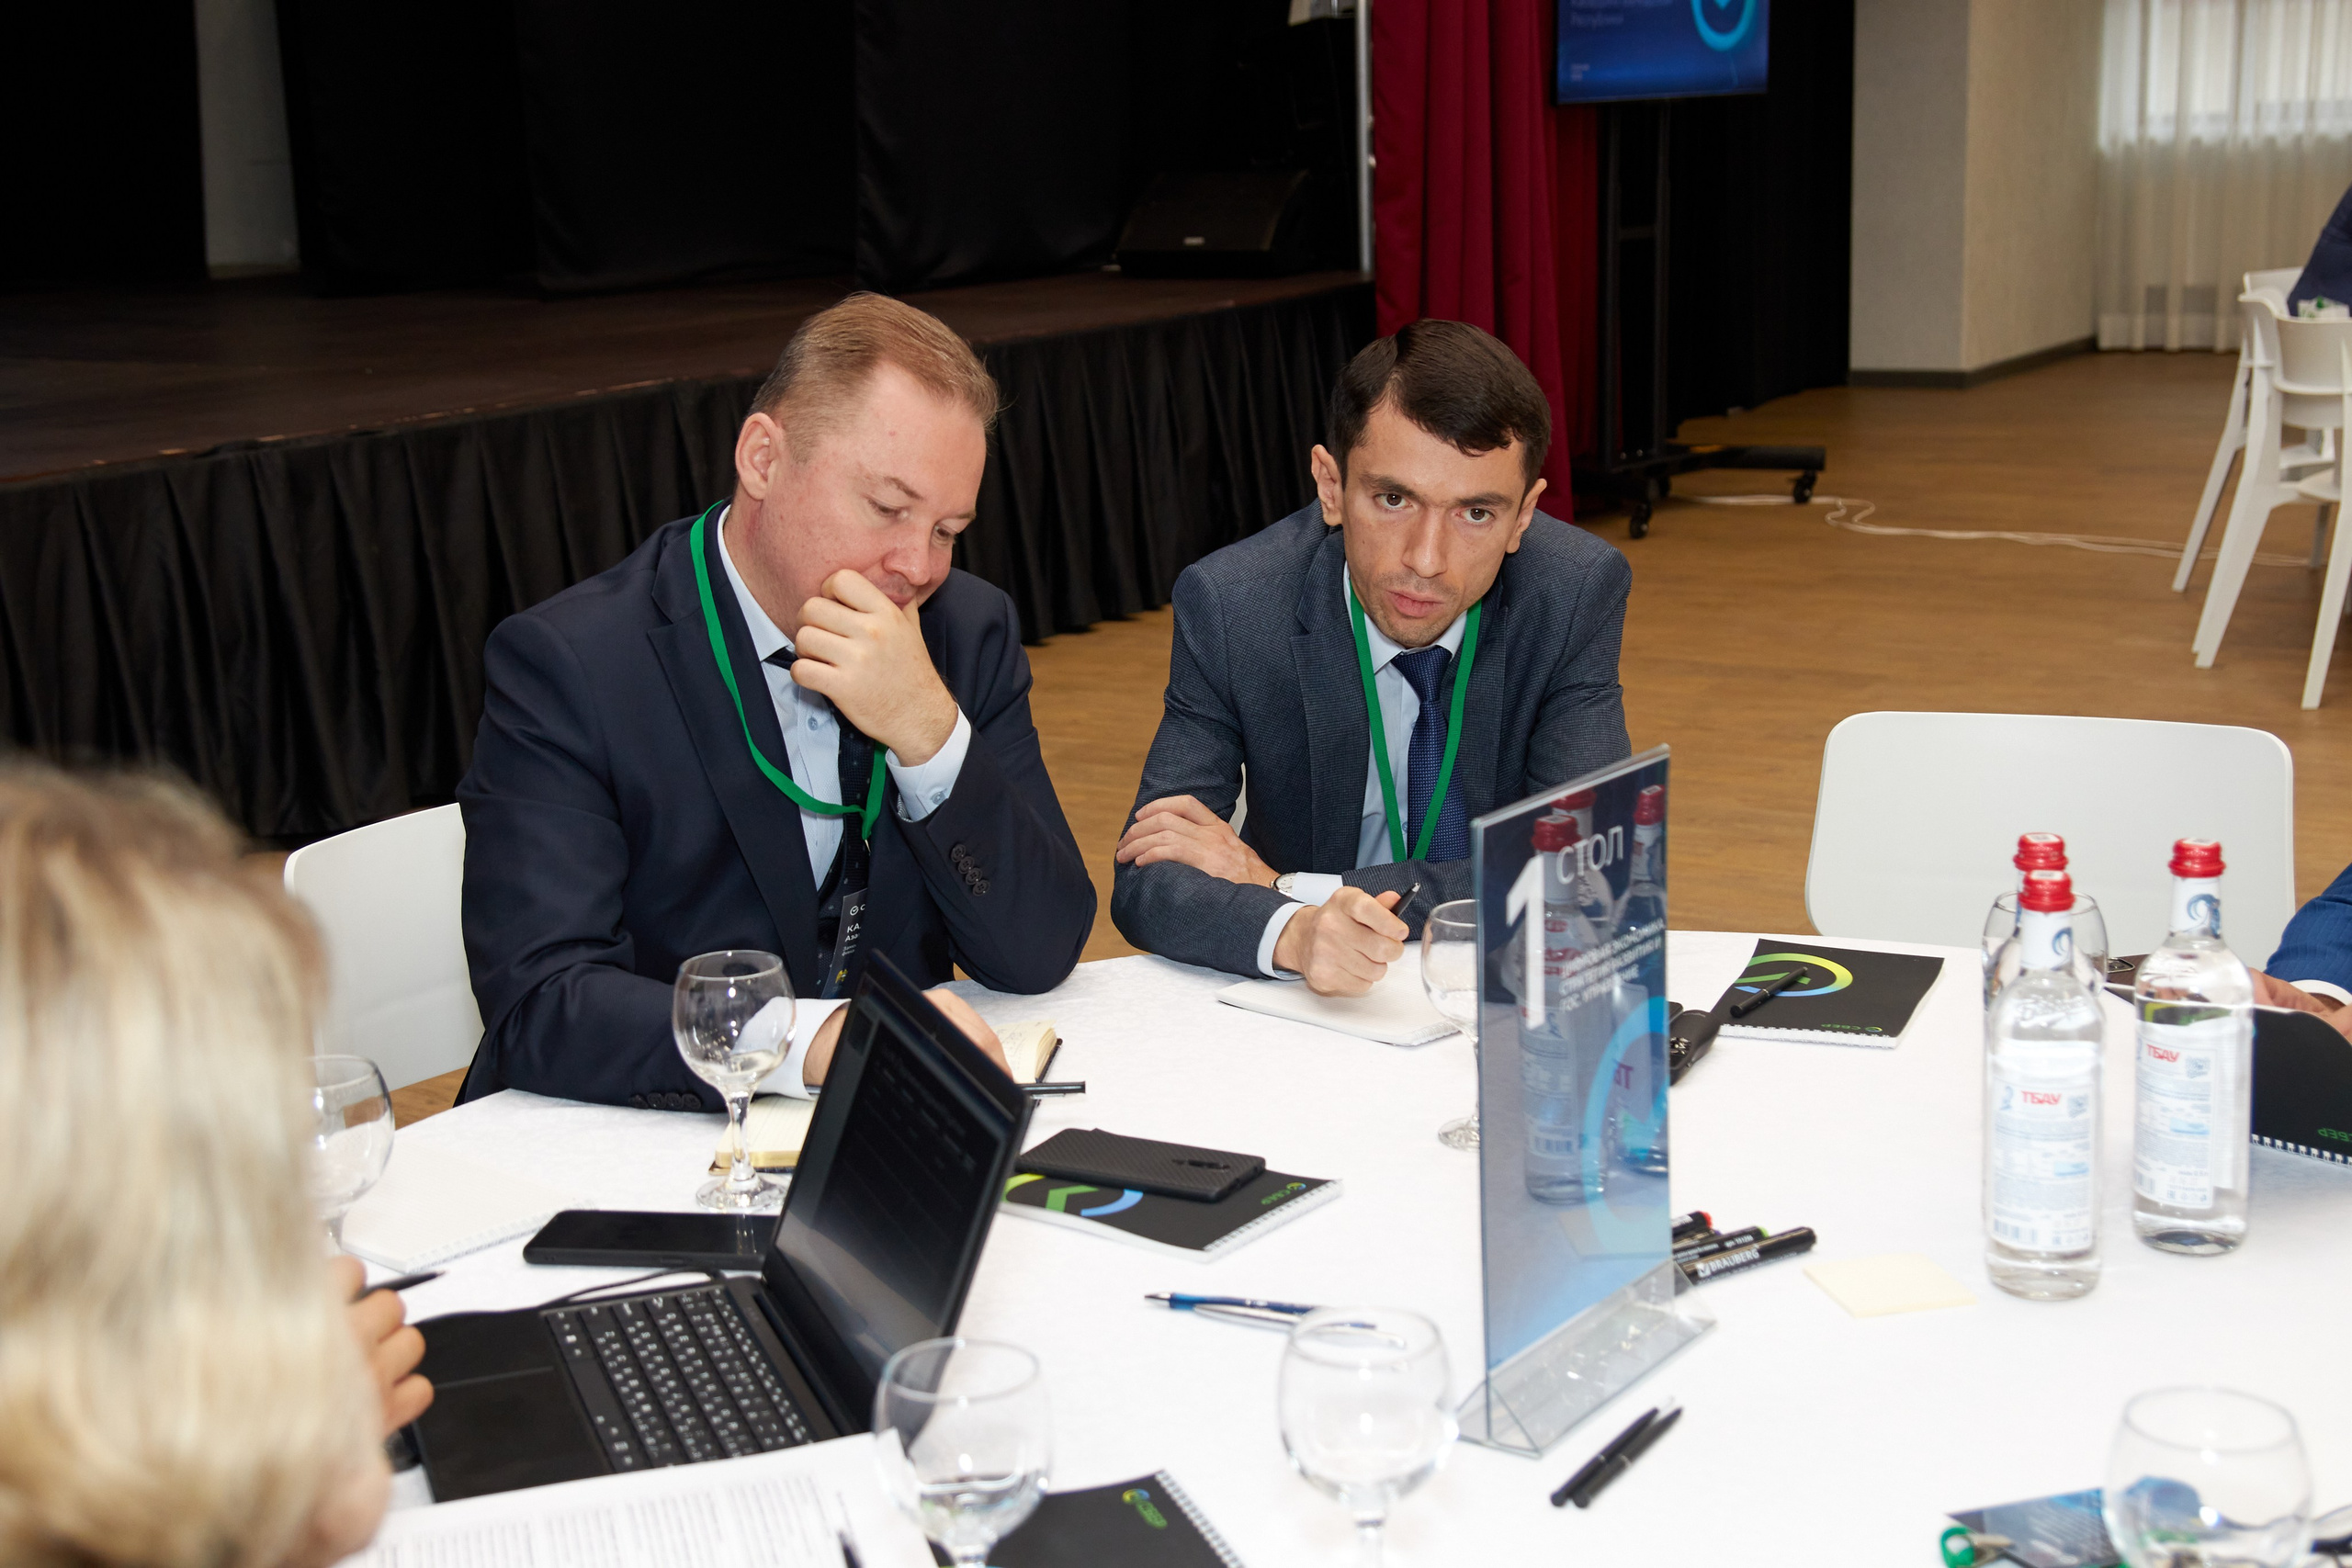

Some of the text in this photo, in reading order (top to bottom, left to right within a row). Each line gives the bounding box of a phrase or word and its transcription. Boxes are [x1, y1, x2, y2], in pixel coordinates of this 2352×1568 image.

[1556, 825, 1623, 885] СТОЛ
[1506, 854, 1545, 1030] 1
[2146, 1043, 2181, 1064] ТБАУ
[2021, 1090, 2062, 1105] ТБАУ
[1709, 1250, 1759, 1272] BRAUBERG
